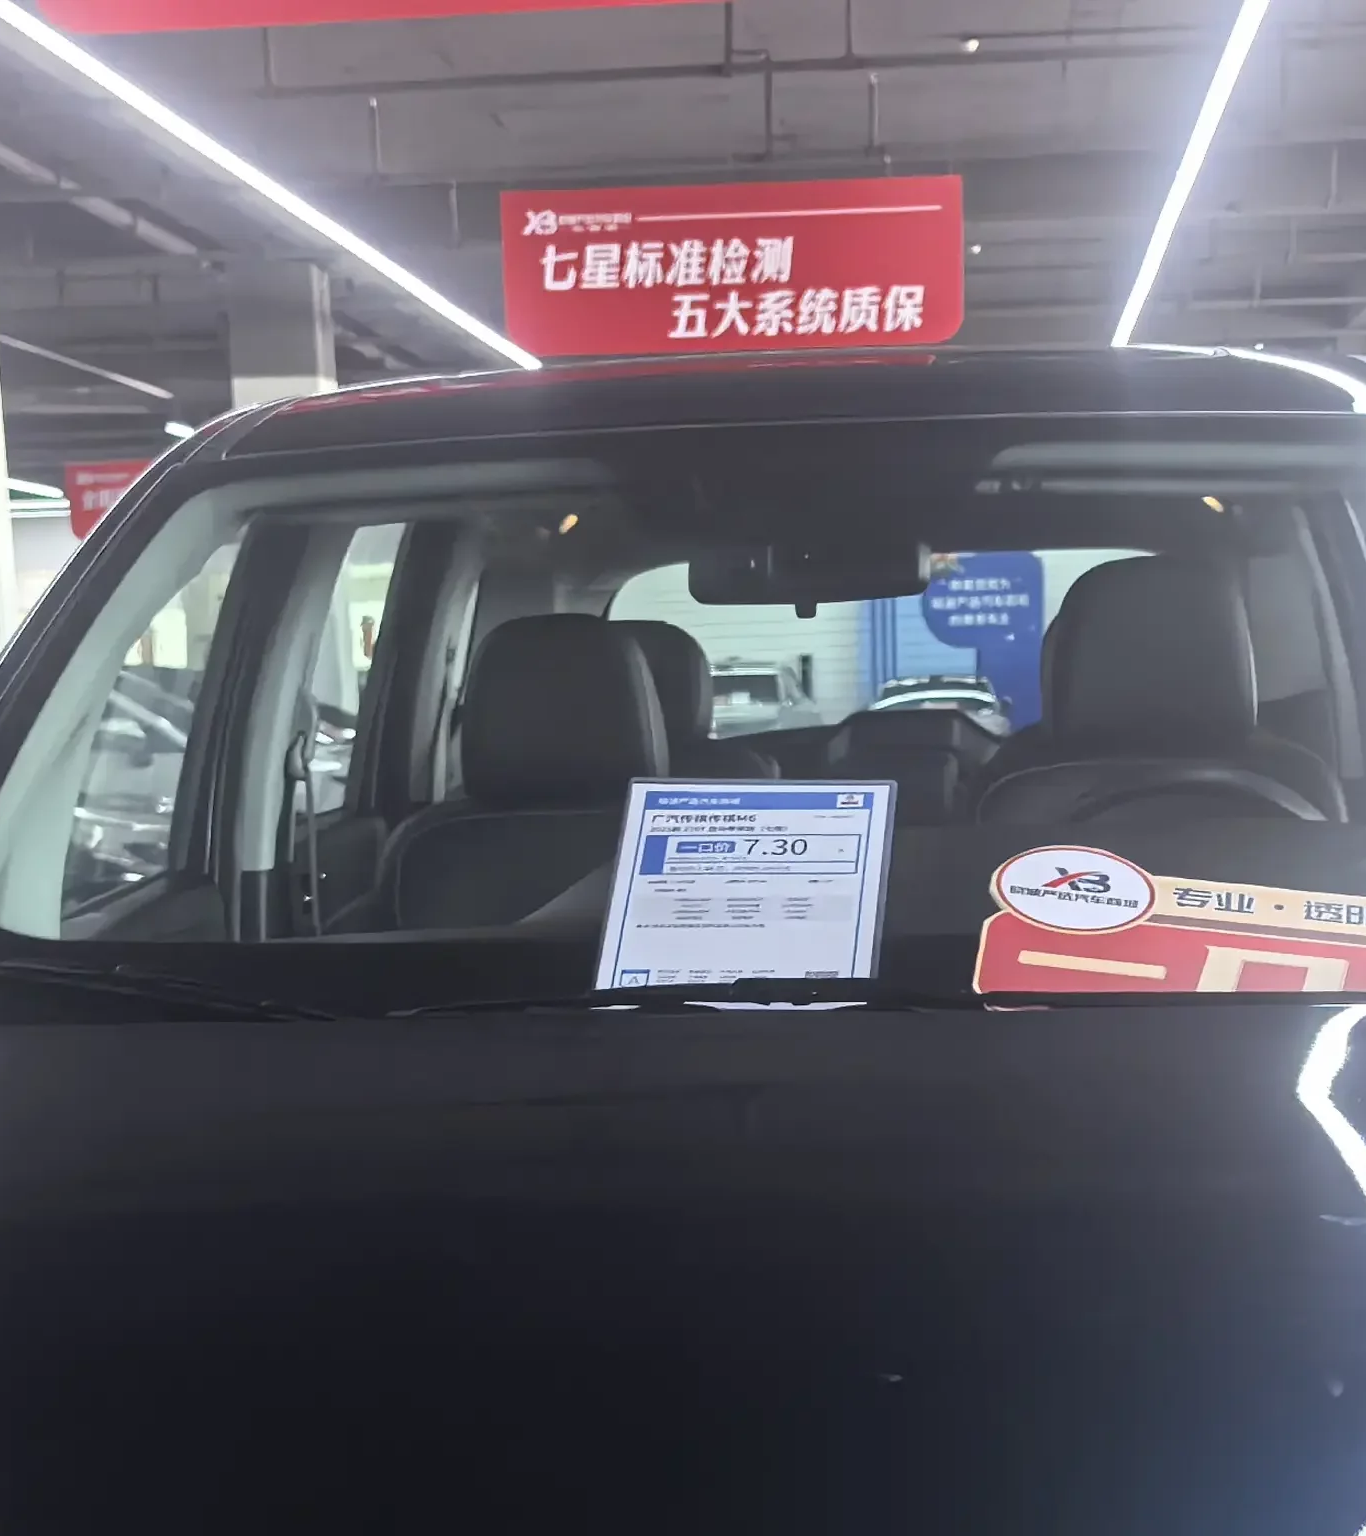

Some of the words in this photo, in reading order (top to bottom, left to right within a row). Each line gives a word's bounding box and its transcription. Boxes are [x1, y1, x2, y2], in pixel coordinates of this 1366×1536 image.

[540, 235, 795, 292] 七星标准检测
[667, 284, 925, 339] 五大系统质保
[680, 842, 731, 854] 一口价
[743, 838, 808, 856] 7.30
